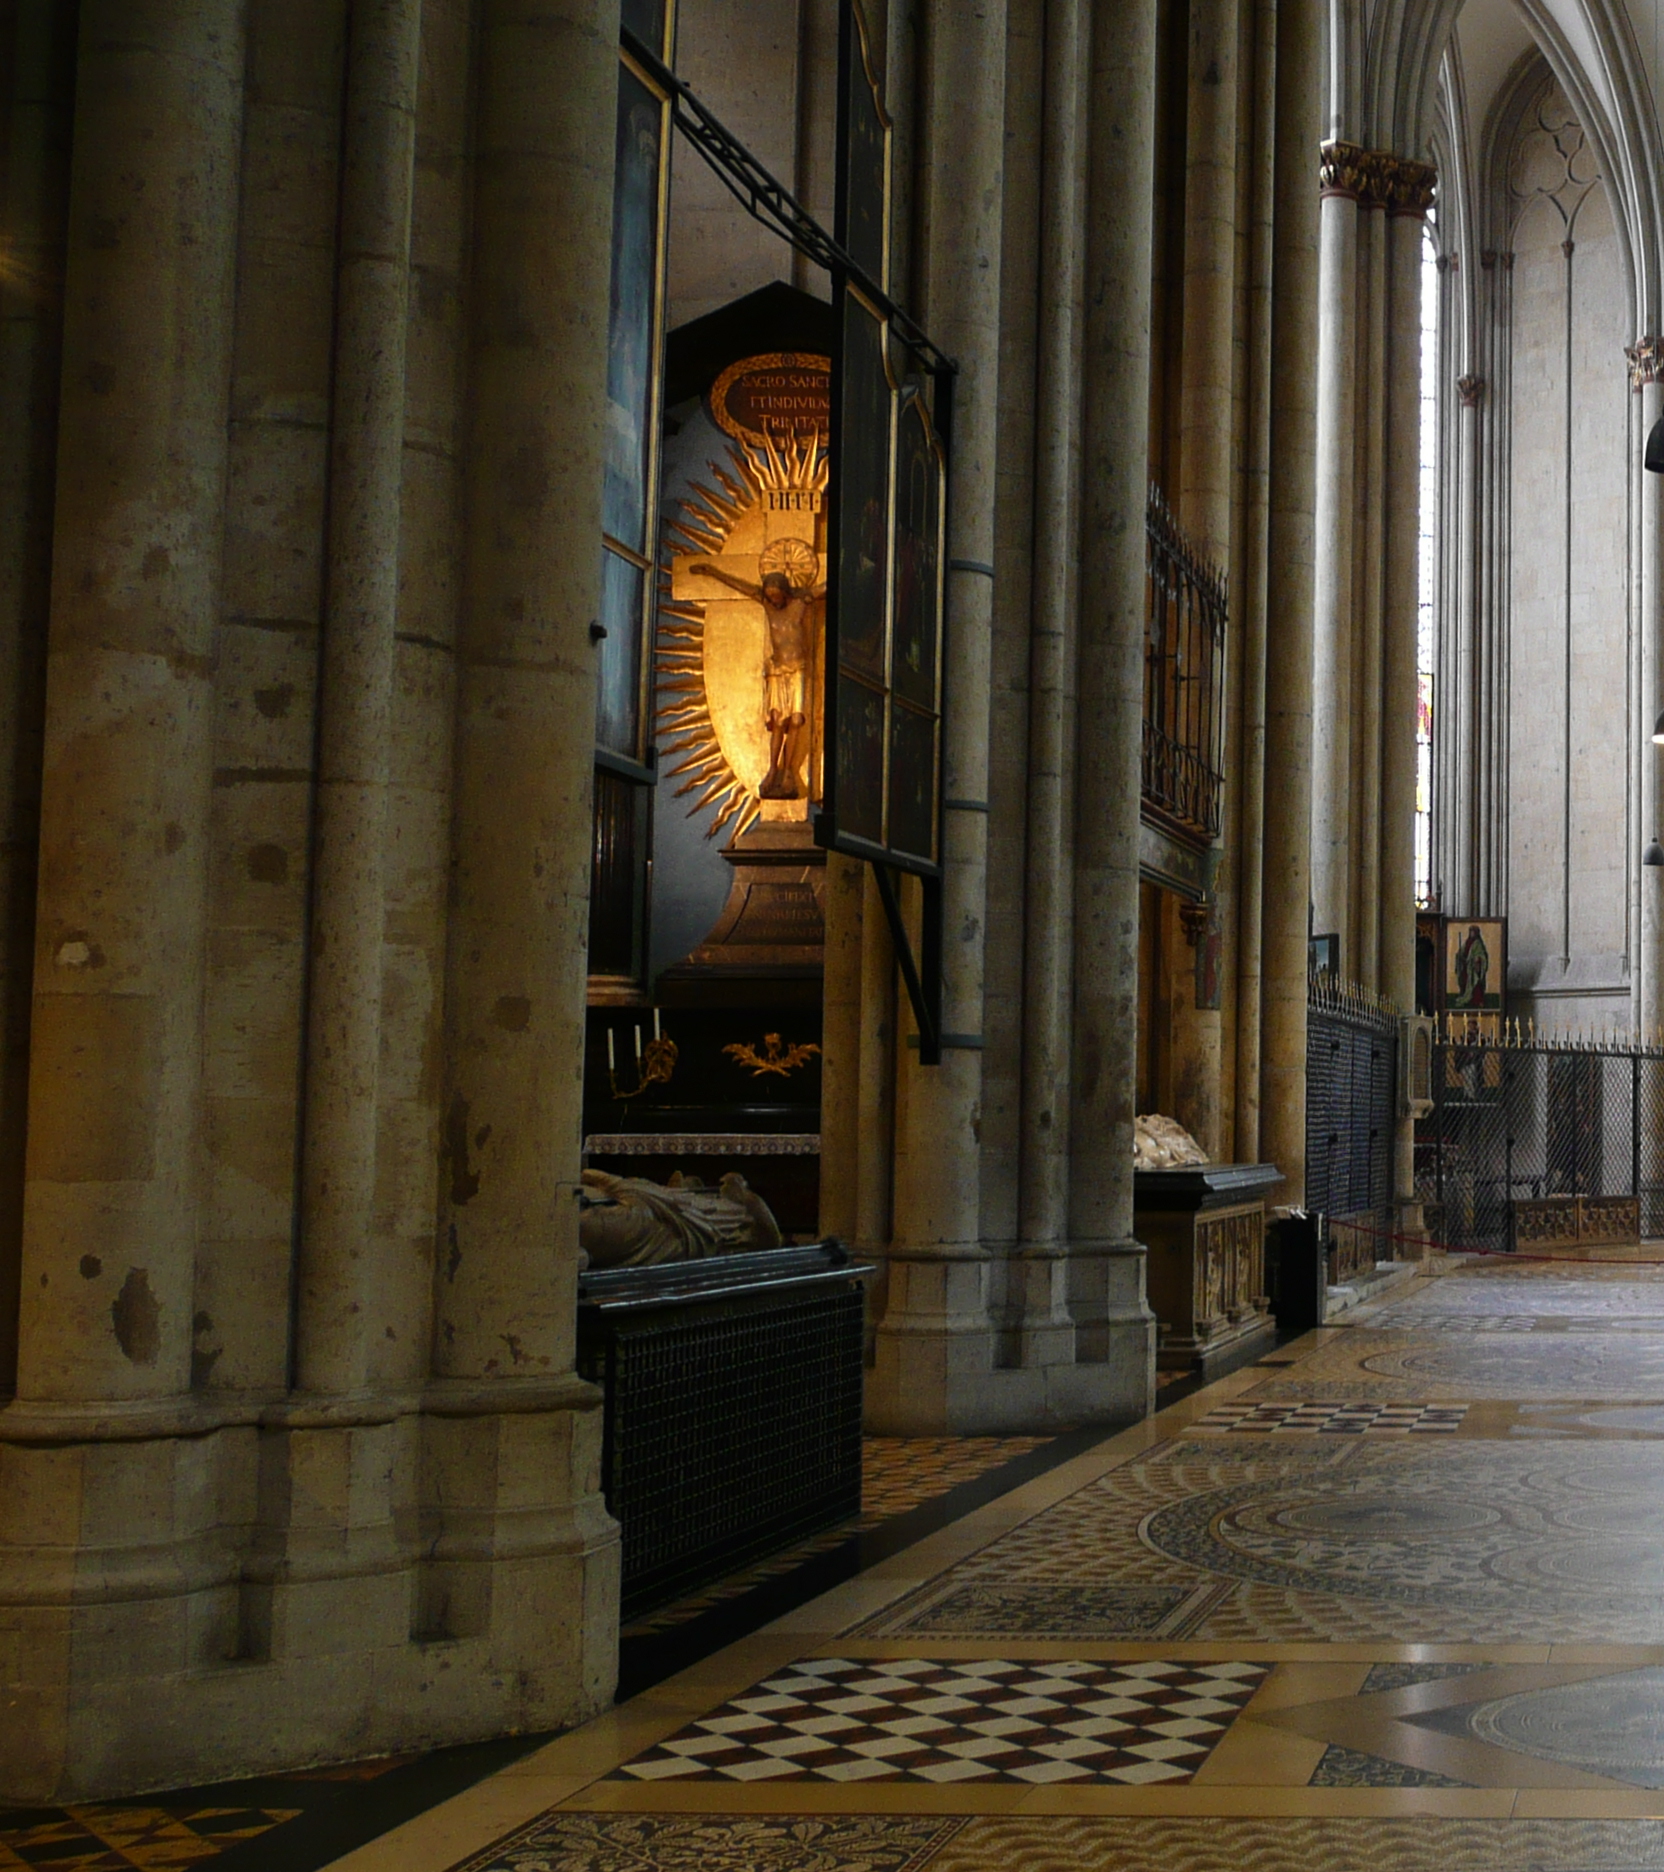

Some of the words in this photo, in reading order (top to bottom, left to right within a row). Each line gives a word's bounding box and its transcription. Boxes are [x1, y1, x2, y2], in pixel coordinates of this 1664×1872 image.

[741, 376, 786, 388] SACRO
[789, 375, 830, 388] SANCT
[768, 395, 830, 410] INDIVIDV
